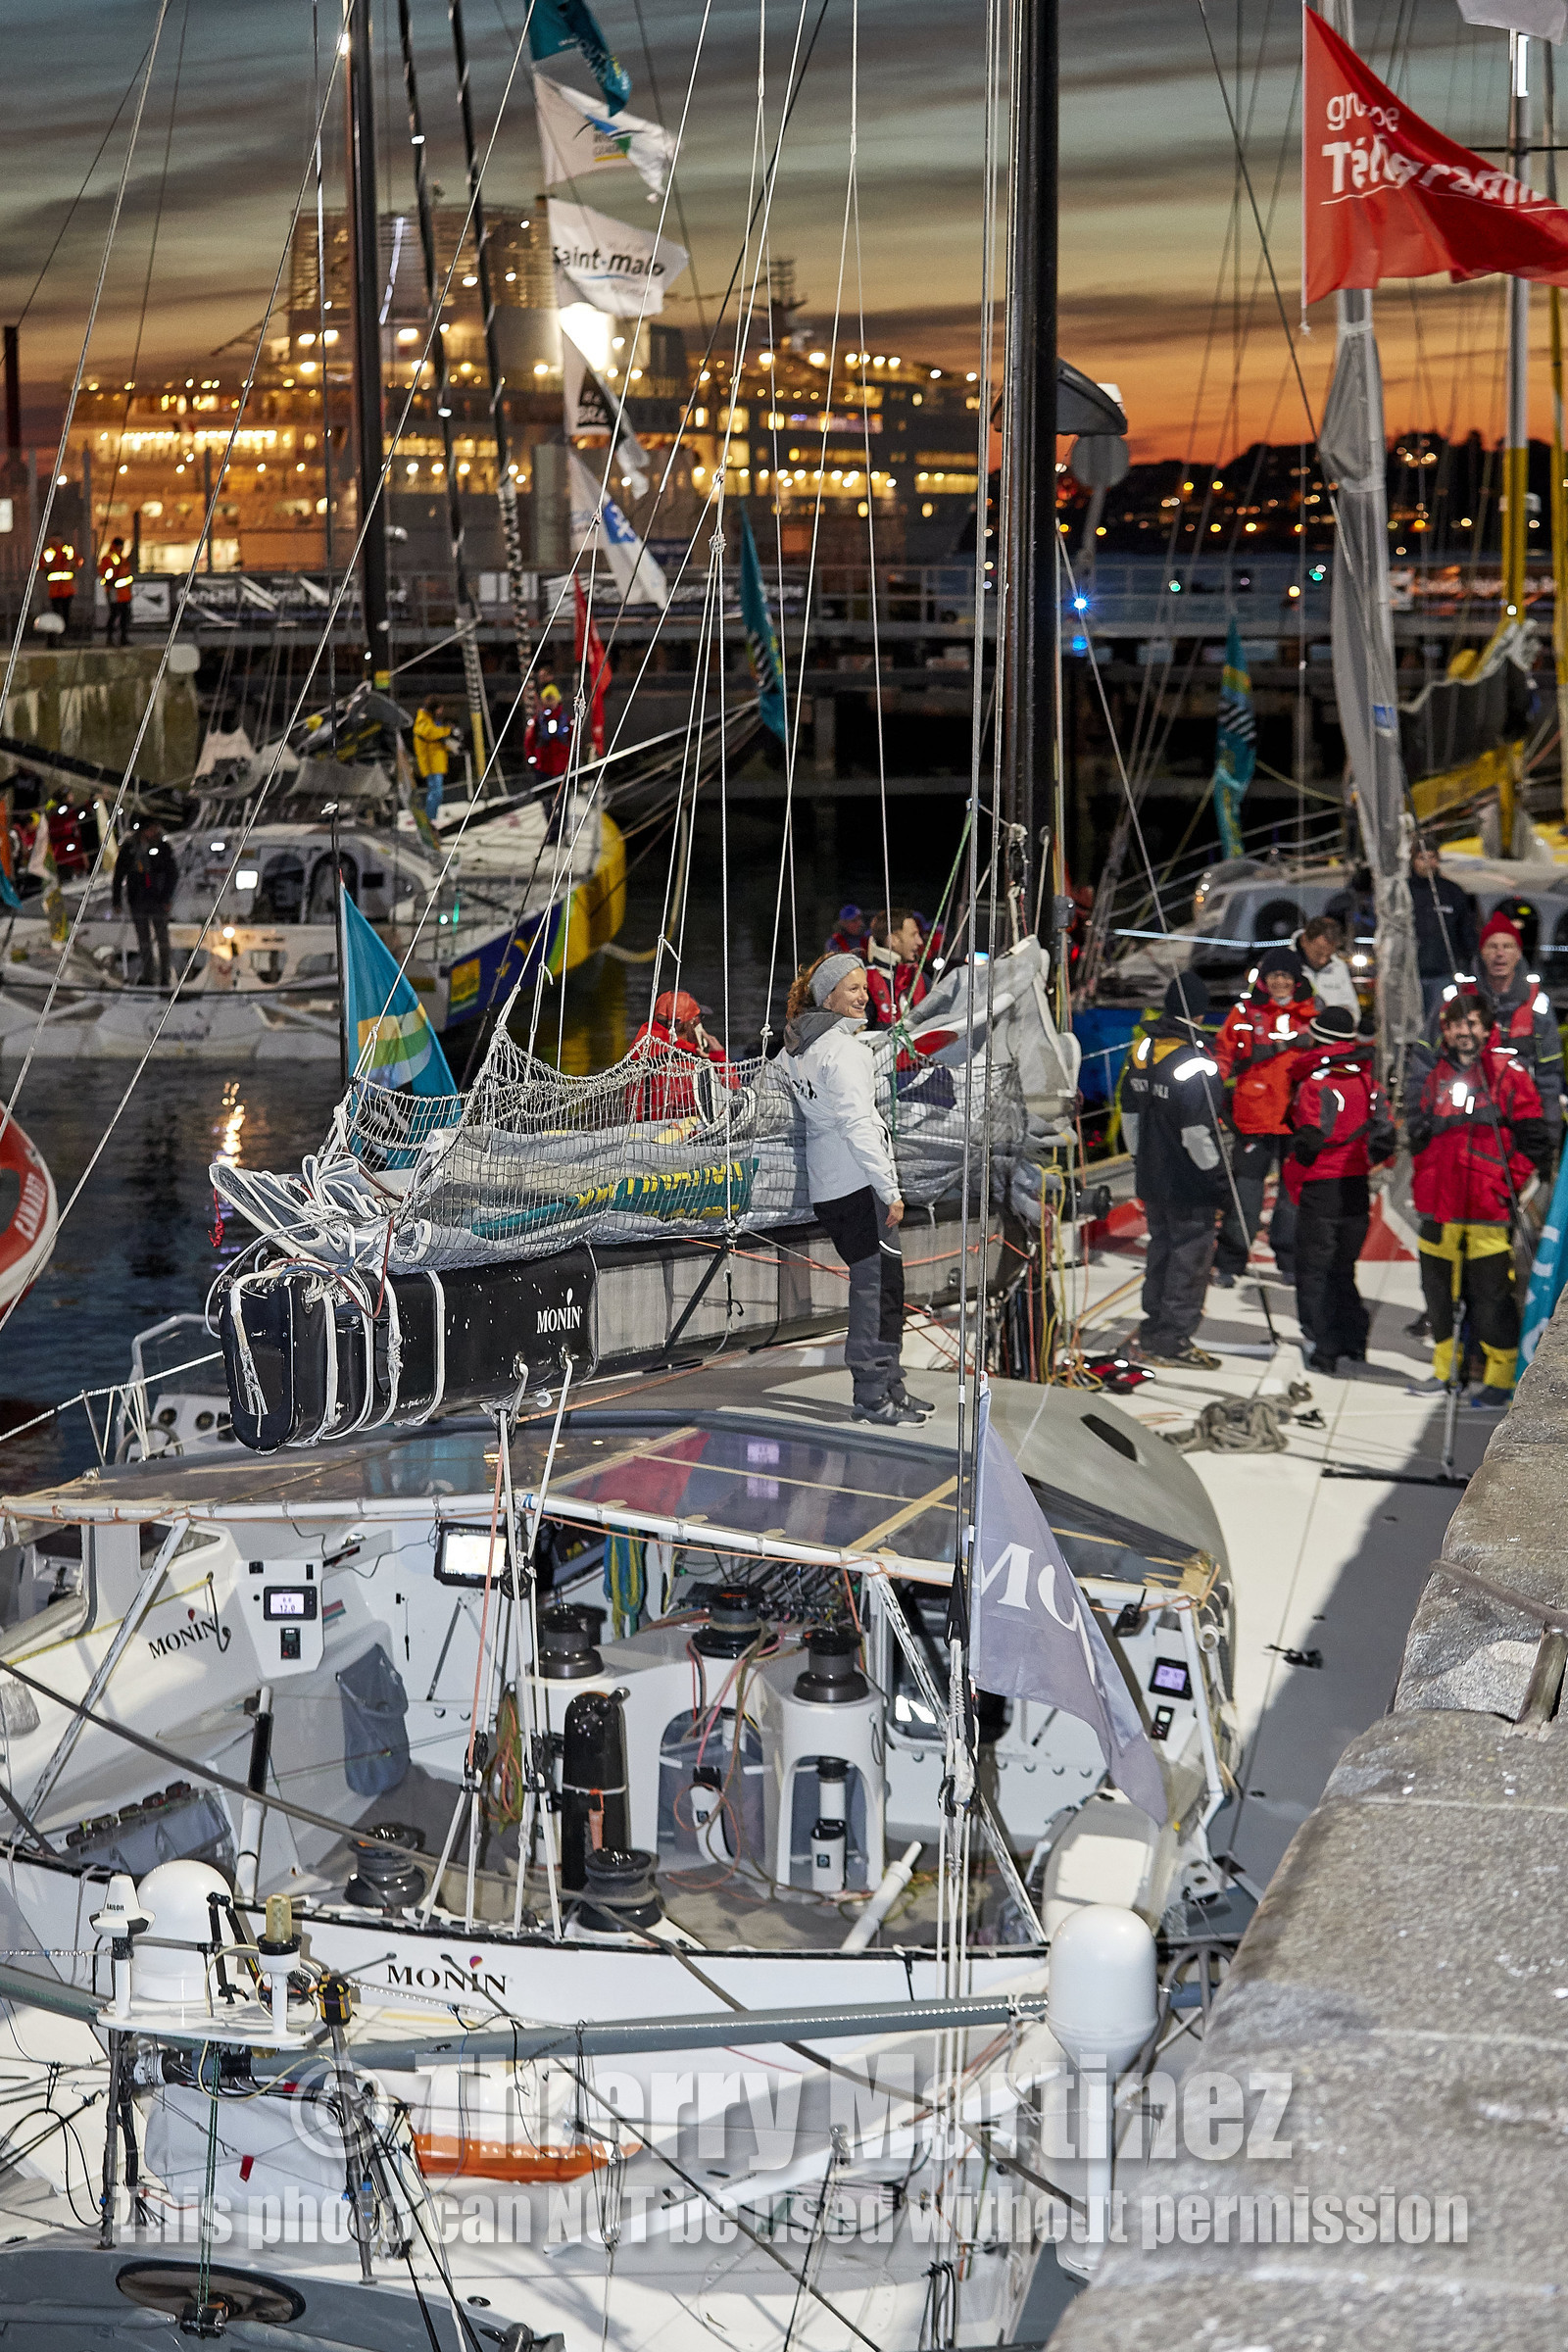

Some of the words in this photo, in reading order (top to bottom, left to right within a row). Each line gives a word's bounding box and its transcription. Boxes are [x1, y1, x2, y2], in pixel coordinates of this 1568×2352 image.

[536, 1304, 582, 1334] MONIN
[148, 1617, 218, 1660] MONIN
[387, 1964, 507, 1996] MONIN
